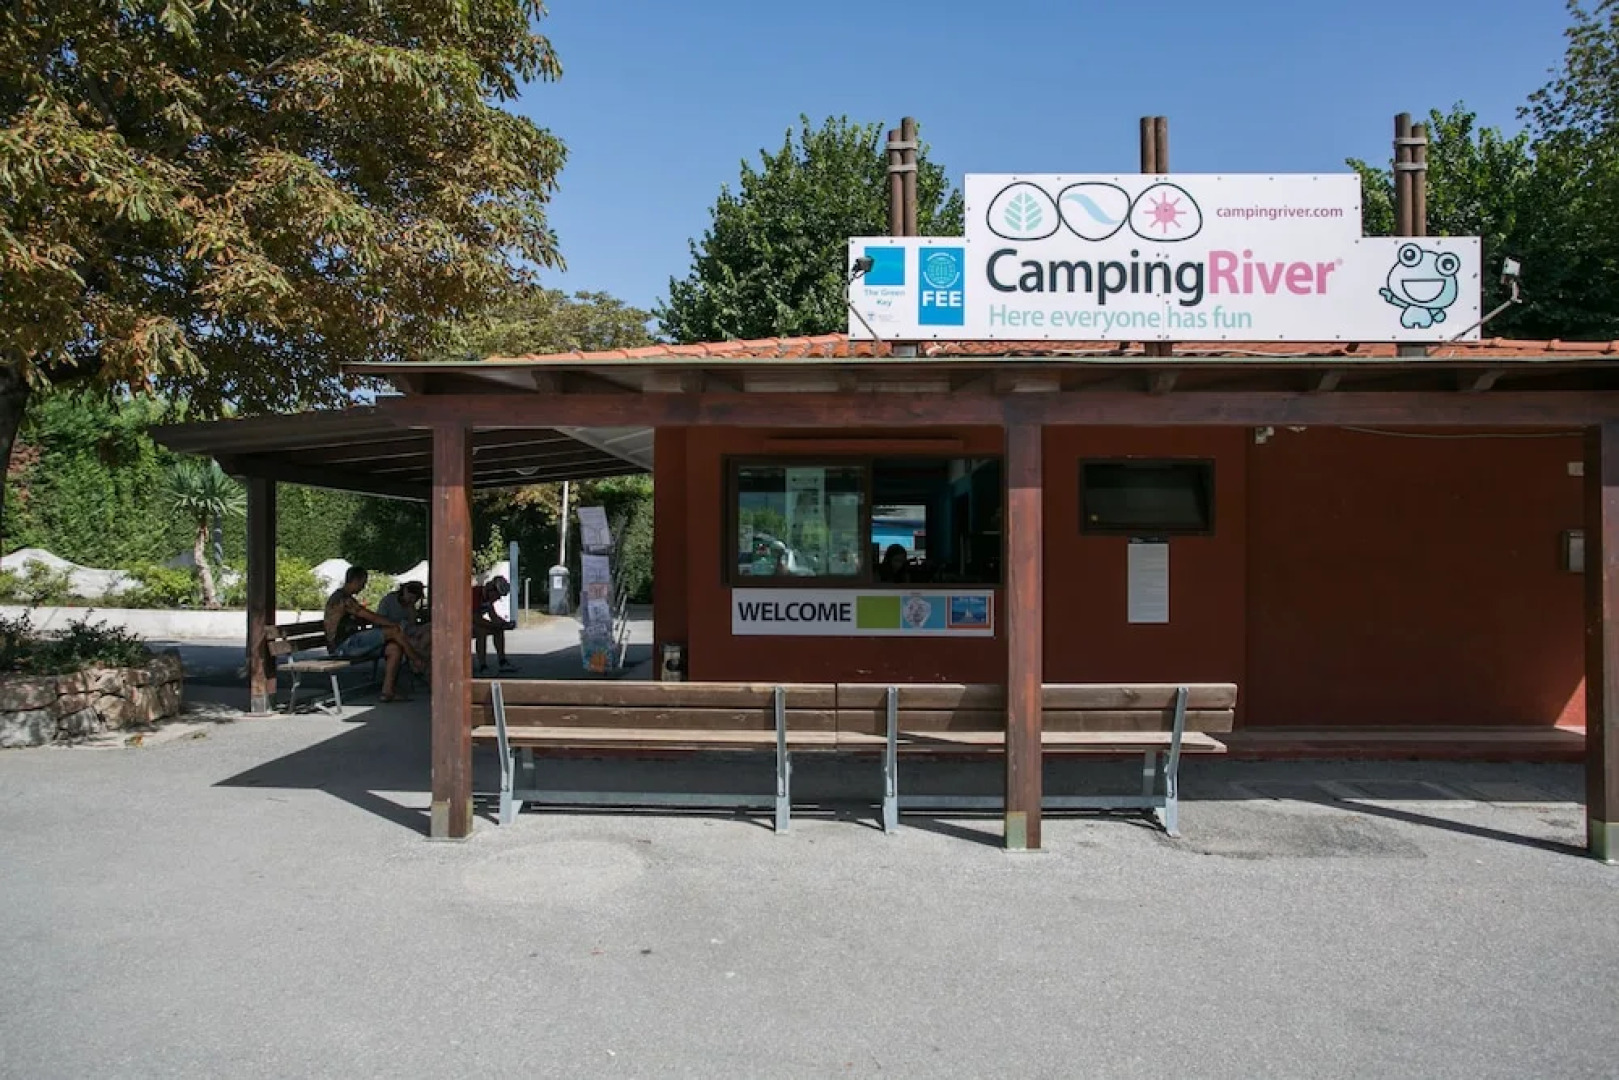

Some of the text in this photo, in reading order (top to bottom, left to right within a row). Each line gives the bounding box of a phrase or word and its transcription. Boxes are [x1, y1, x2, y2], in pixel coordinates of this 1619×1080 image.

[1216, 205, 1343, 220] campingriver.com
[922, 290, 962, 307] FEE
[990, 305, 1252, 332] Here everyone has fun
[738, 601, 852, 622] WELCOME
